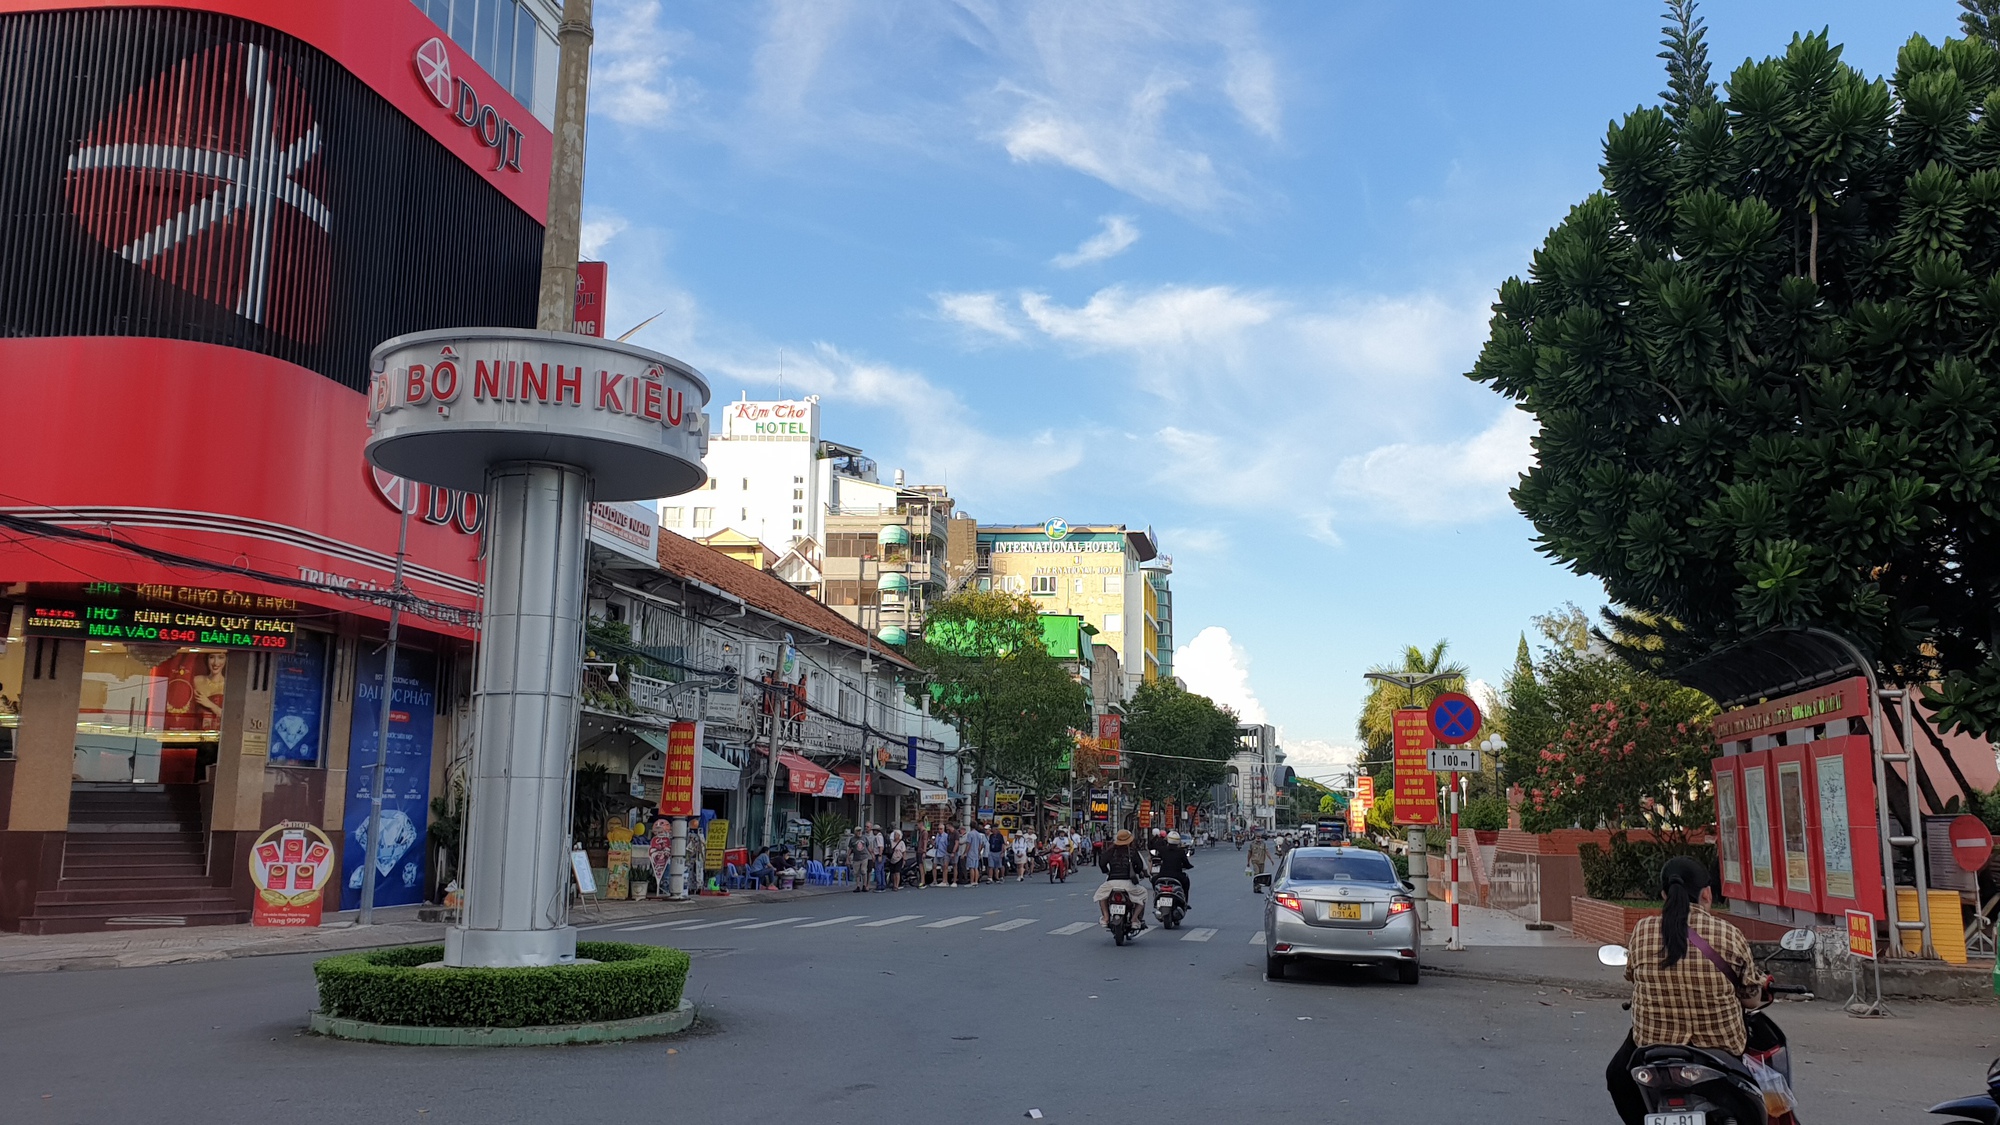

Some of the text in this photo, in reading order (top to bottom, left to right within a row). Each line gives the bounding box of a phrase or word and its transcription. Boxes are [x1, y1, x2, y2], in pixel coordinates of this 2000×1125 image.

[454, 75, 525, 173] DOJI
[406, 346, 458, 416] BỘ
[473, 358, 582, 406] NINH
[598, 363, 683, 428] KIỀU
[735, 403, 770, 421] Kim
[755, 421, 809, 435] HOTEL
[629, 517, 652, 538] NAM
[995, 541, 1121, 554] INTERNATIONAL HOTEL
[1036, 566, 1123, 575] INTERNATIONAL HOTEL
[89, 623, 287, 648] MUA VÀO 6.940 BÁN RA 7.030
[359, 682, 378, 702] ĐẠI
[403, 688, 432, 706] PHÁT
[1443, 754, 1459, 767] 100
